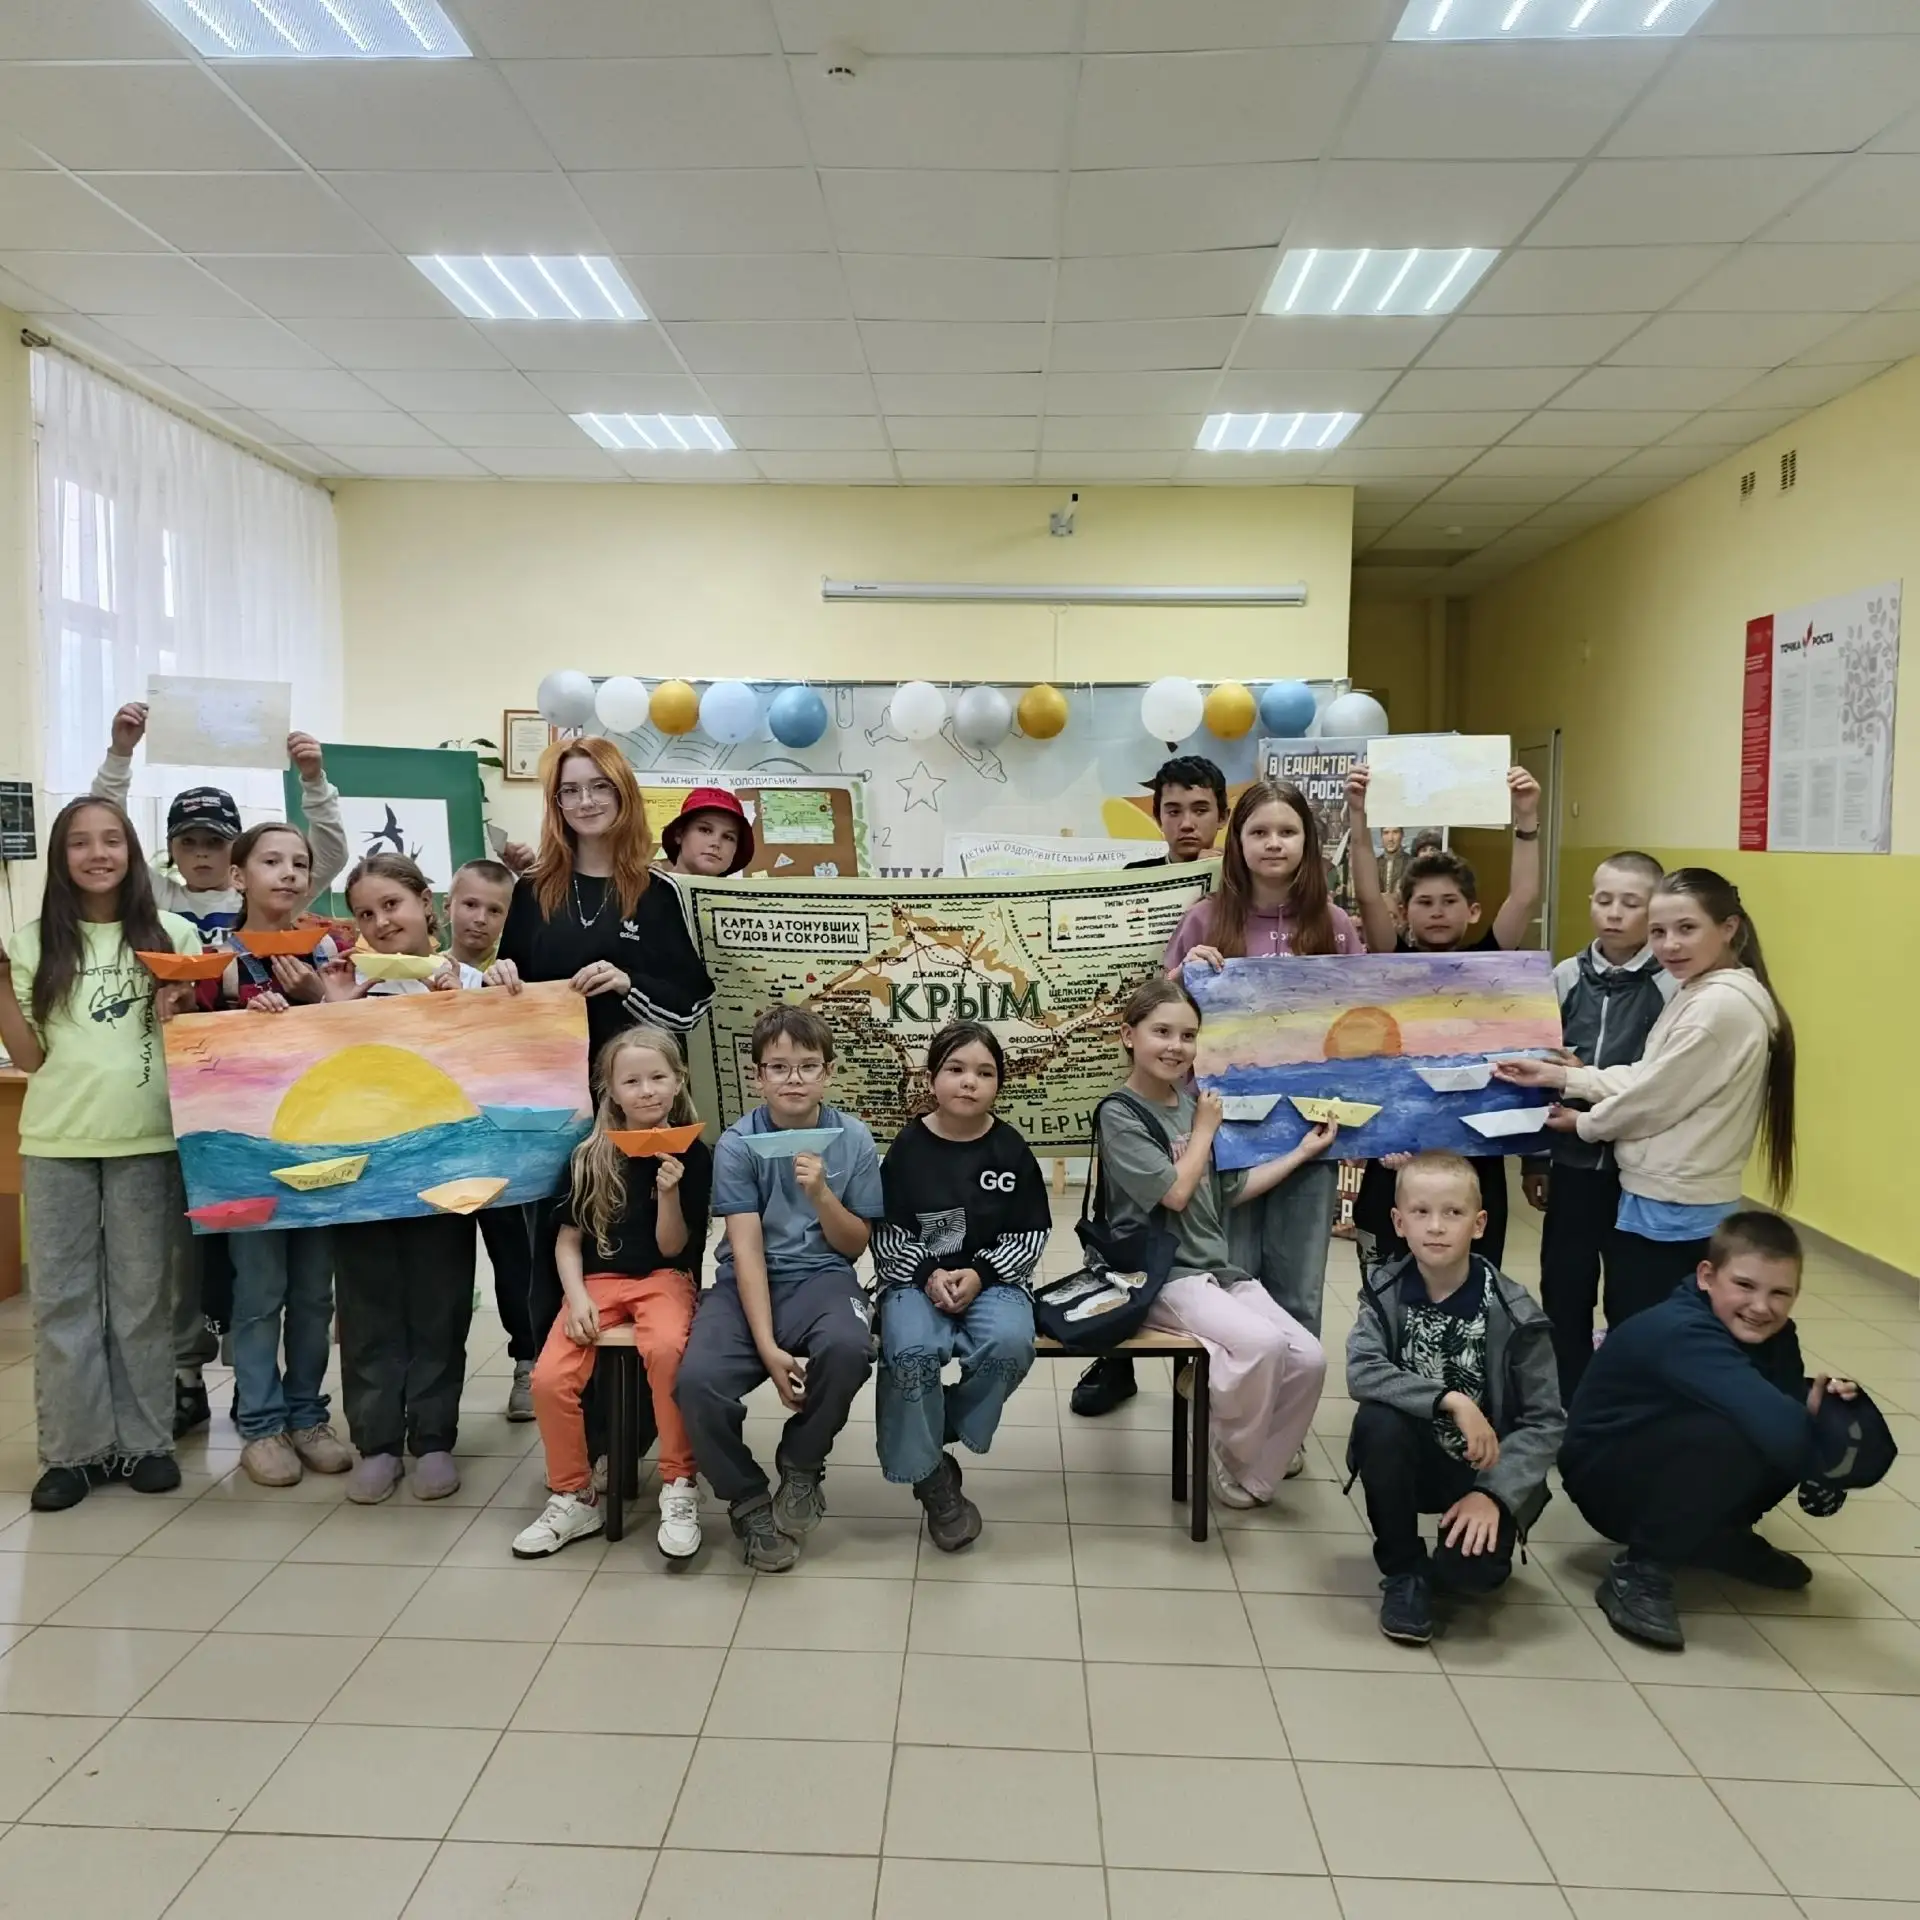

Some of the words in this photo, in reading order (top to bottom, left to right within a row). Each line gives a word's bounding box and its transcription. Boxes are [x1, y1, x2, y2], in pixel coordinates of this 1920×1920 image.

[1812, 632, 1834, 645] РОСТА
[1269, 756, 1278, 775] В
[661, 775, 700, 785] МАГНИТ
[706, 777, 720, 786] НА
[729, 776, 799, 787] ХОЛОДИЛЬНИК
[1309, 780, 1345, 800] РОСС
[964, 841, 1000, 862] ЛЕТНИЙ
[1004, 844, 1095, 863] ОЗДОРОВИТЕЛЬНЫЙ
[1096, 852, 1126, 862] ЛАГЕРЬ
[1126, 898, 1150, 906] СУДОВ
[720, 917, 764, 930] КАРТА
[768, 919, 860, 932] ЗАТОНУВШИХ
[723, 929, 768, 943] СУДОВ
[772, 932, 781, 942] И
[785, 932, 859, 946] СОКРОВИЩ
[912, 969, 960, 979] ДЖАНКОЙ
[887, 981, 1045, 1022] КРЫМ
[1018, 1110, 1093, 1134] ЧЕРН
[980, 1170, 1016, 1193] GG
